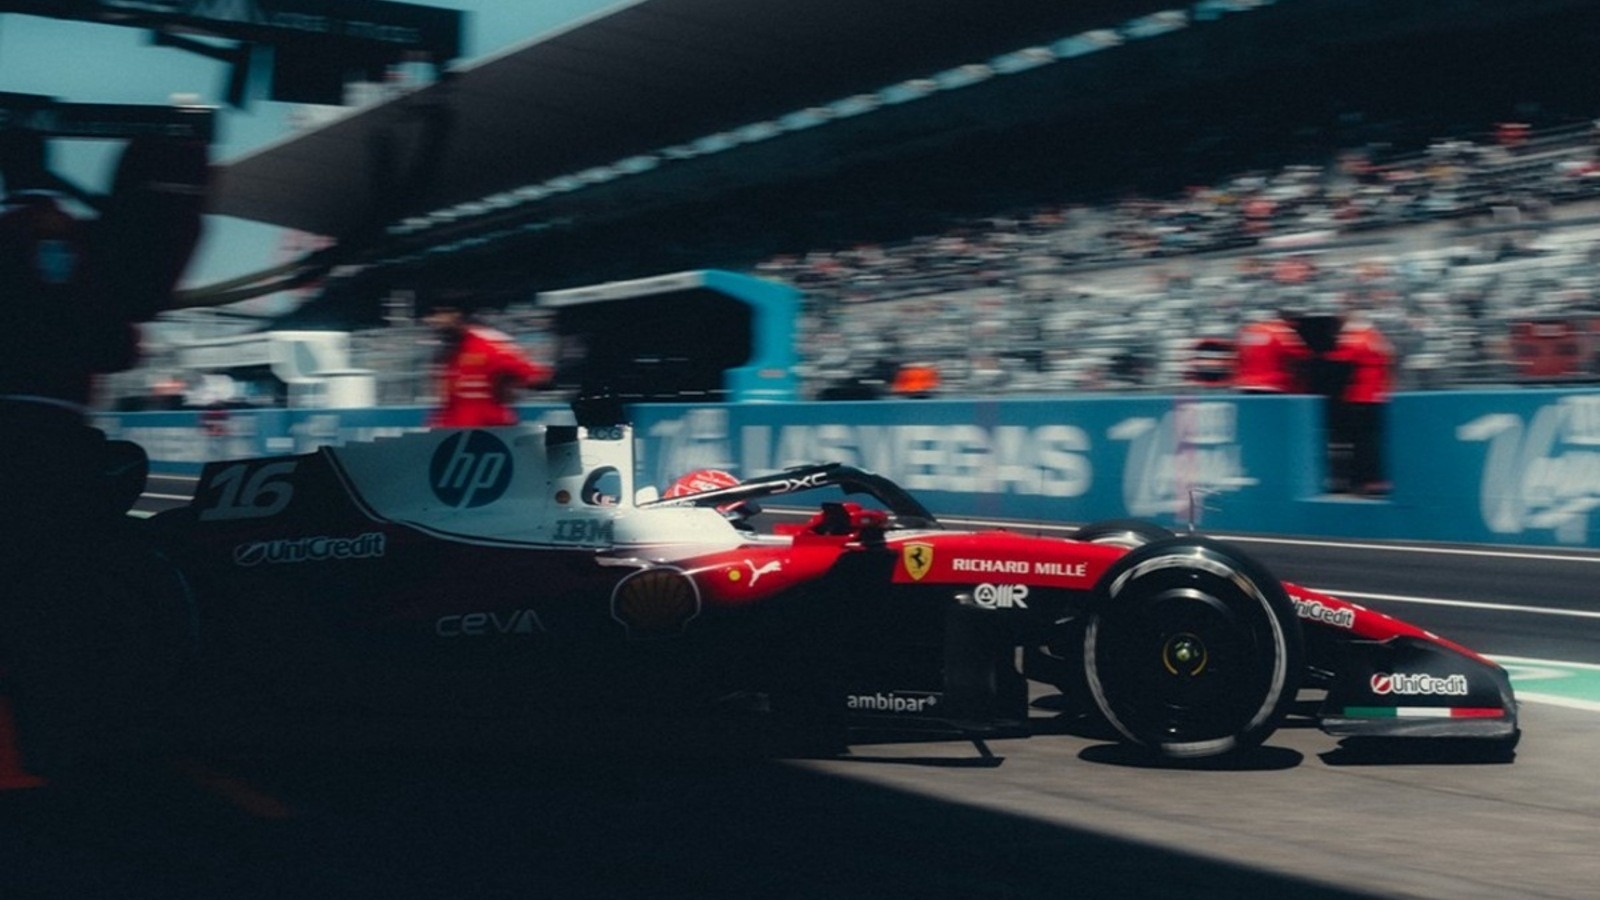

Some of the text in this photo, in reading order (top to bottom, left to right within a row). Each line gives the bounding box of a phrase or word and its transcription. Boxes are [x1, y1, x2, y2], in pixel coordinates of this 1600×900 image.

[437, 430, 506, 508] hp
[856, 425, 1092, 498] VEGAS
[200, 461, 299, 521] 16
[769, 471, 828, 494] DXC
[553, 519, 614, 541] IBM
[266, 533, 384, 562] UniCredit
[952, 558, 1087, 577] RICHARD MILLE
[1392, 674, 1467, 695] UniCredit
[846, 691, 925, 712] ambipar
